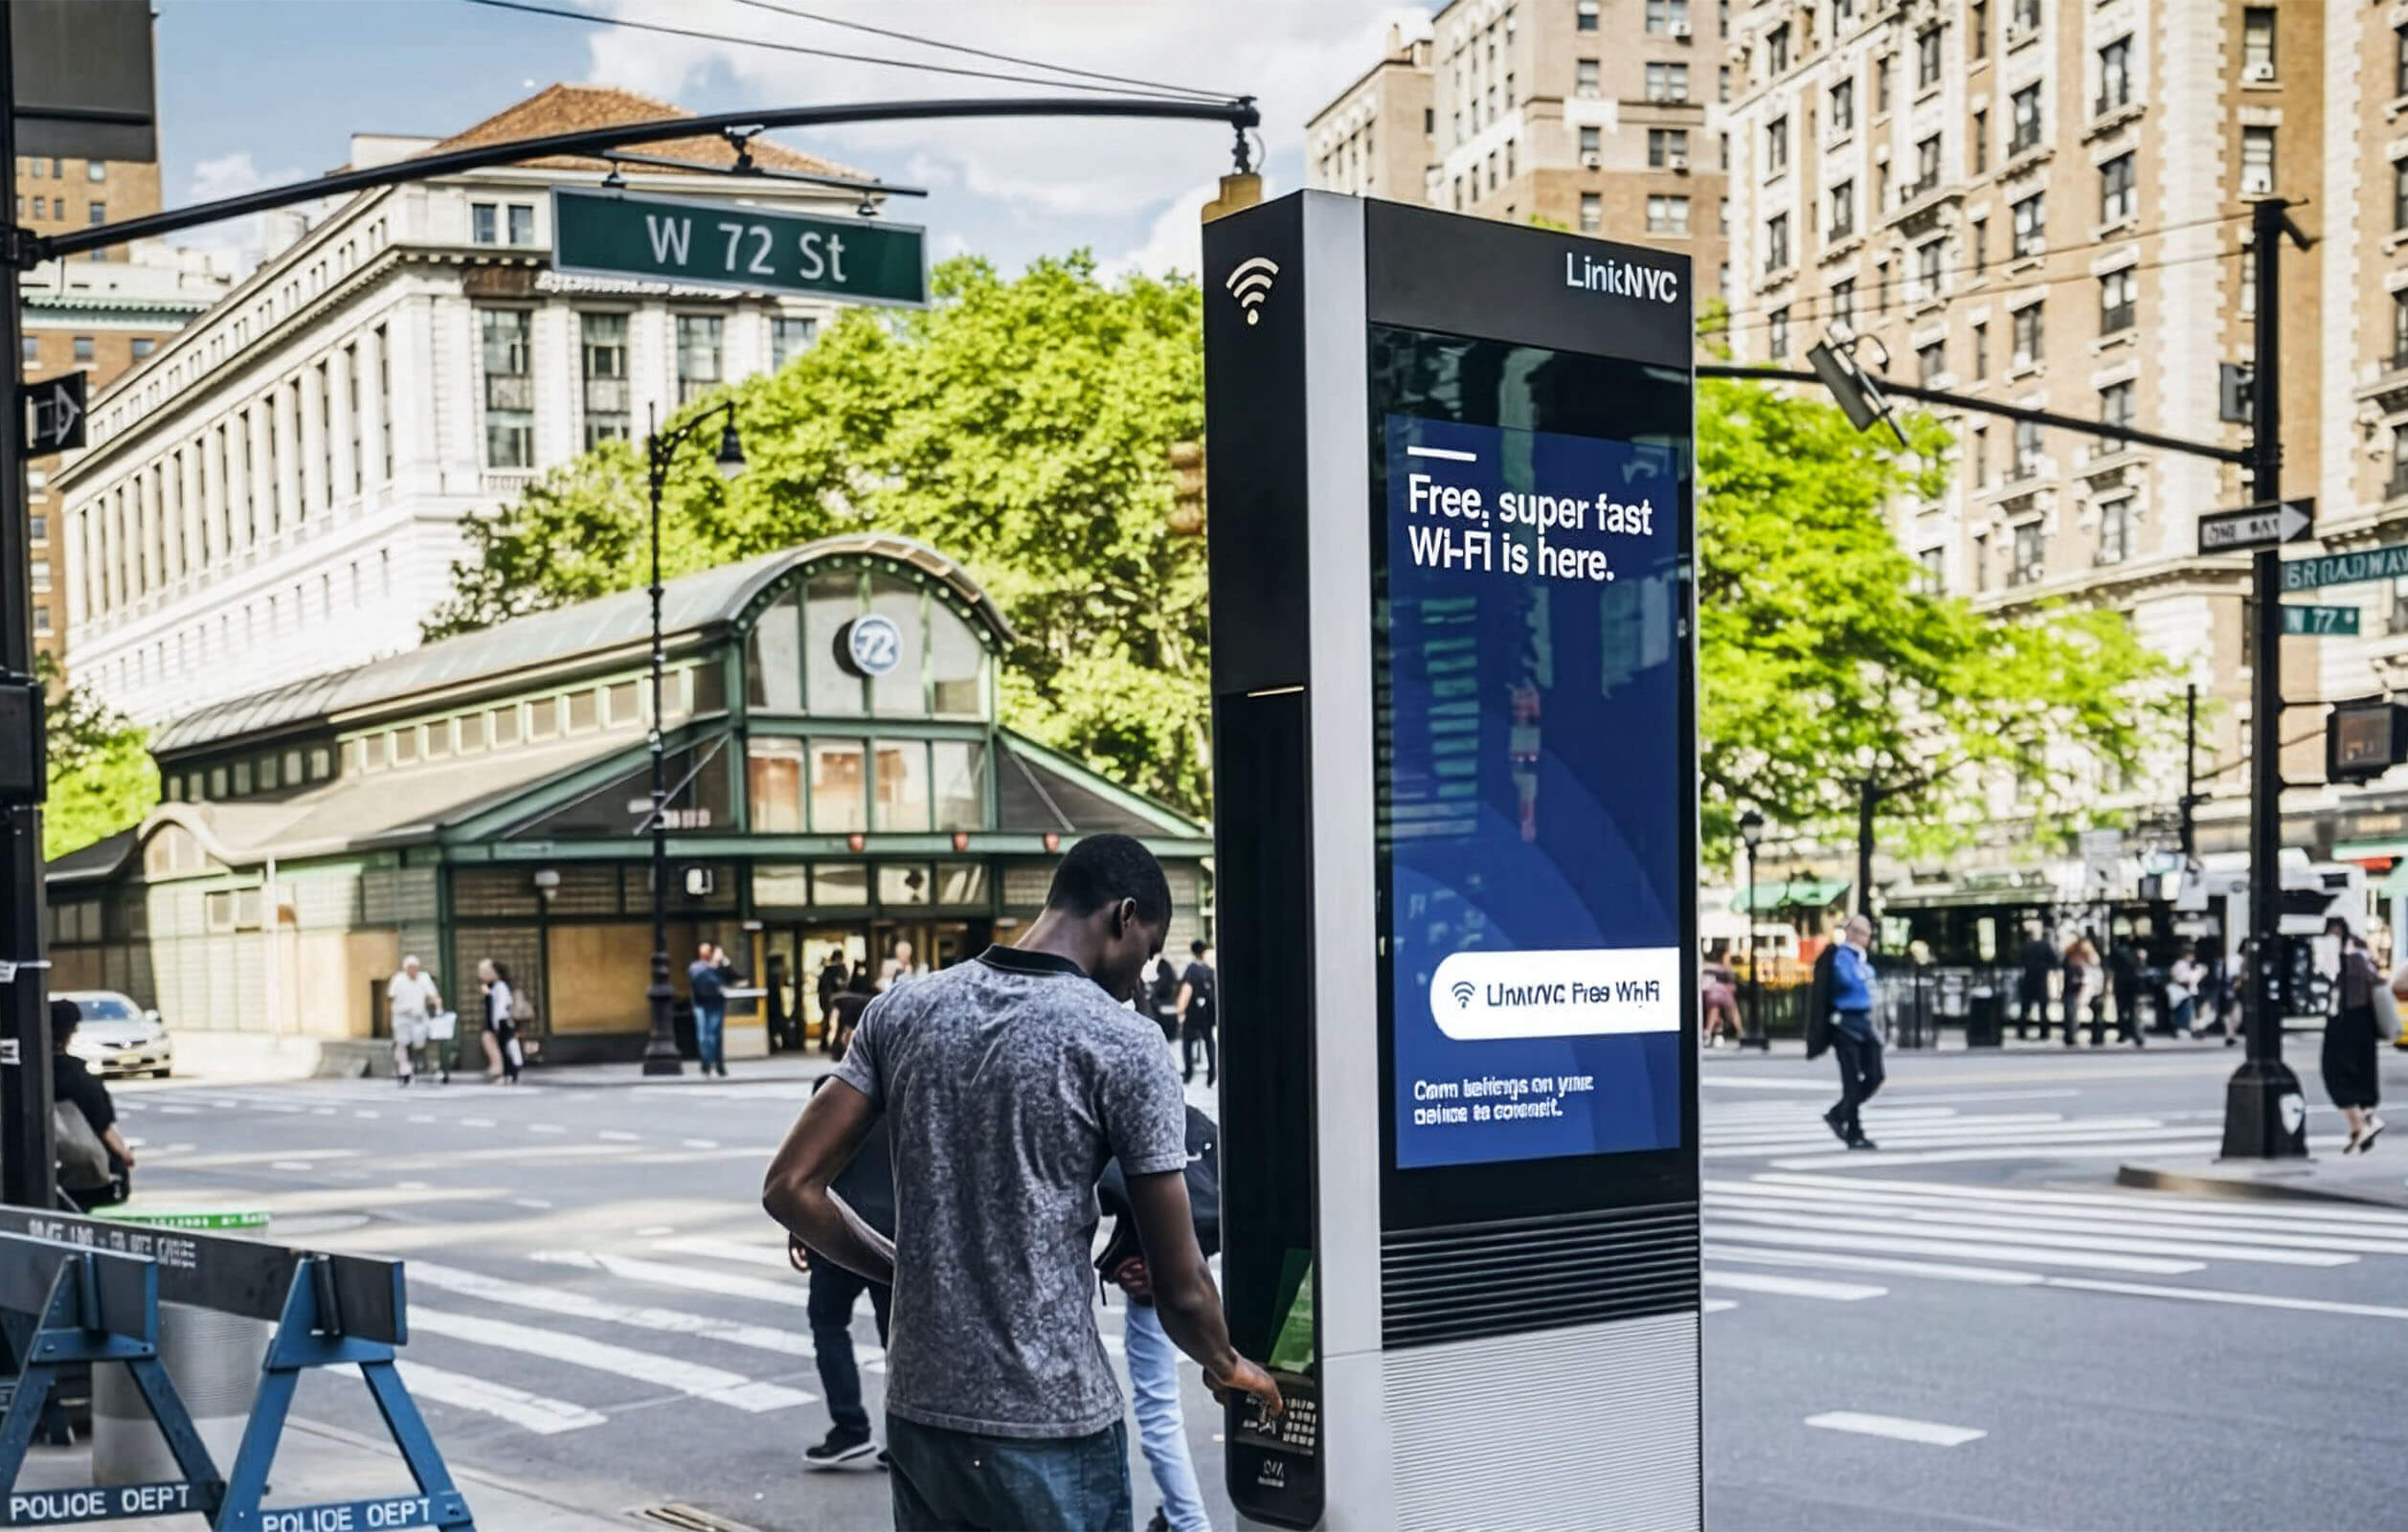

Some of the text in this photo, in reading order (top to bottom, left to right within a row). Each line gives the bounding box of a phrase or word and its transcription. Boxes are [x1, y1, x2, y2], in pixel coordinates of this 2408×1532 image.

[645, 214, 847, 283] W 72 St
[1565, 252, 1678, 304] LinkNYC
[1498, 491, 1589, 535] super
[1594, 492, 1654, 536] fast
[1501, 532, 1530, 574] is
[1537, 535, 1615, 582] here.
[859, 629, 894, 665] 72
